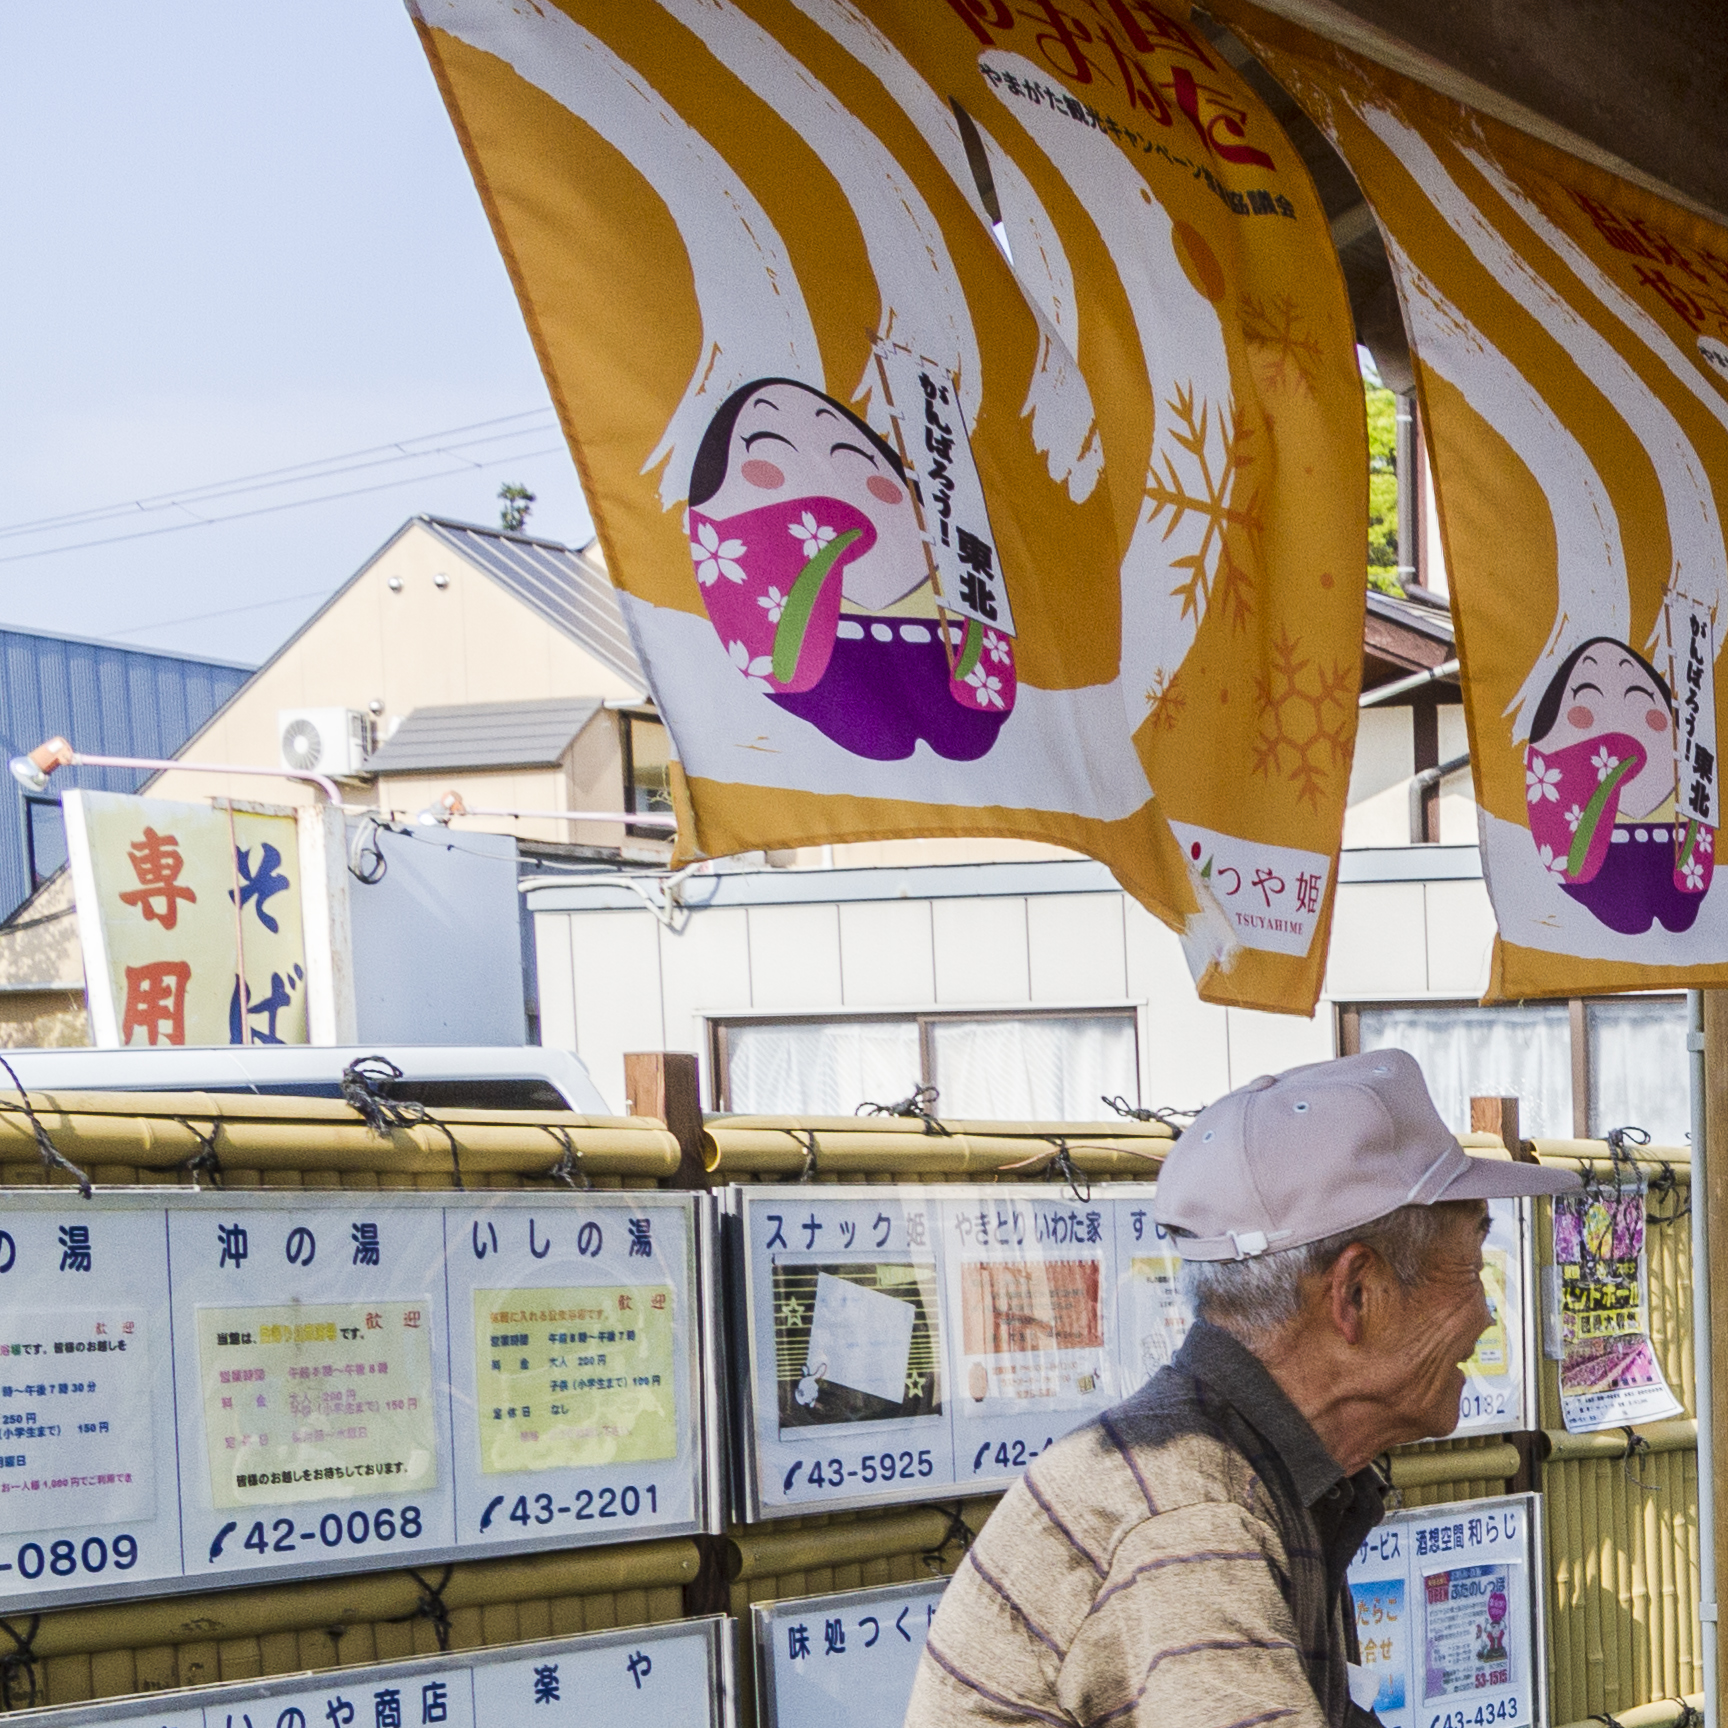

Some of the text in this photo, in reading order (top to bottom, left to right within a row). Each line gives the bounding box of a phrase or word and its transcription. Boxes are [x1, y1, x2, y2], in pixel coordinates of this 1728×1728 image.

[955, 525, 998, 622] 東北
[1688, 742, 1715, 819] 東北
[1217, 867, 1323, 914] つや姫
[118, 826, 197, 1045] 専用
[229, 841, 303, 1045] そば
[1235, 911, 1304, 936] TSUYAHIME
[216, 1221, 381, 1270] 沖の湯
[471, 1216, 653, 1260] いしの湯
[765, 1211, 927, 1251] スナック姫
[954, 1208, 1103, 1248] やきとり いわた家
[365, 1310, 421, 1330] 歓迎
[807, 1448, 934, 1490] 43-5925
[508, 1483, 660, 1526] 43-2201
[243, 1505, 424, 1557] 42-0068
[1468, 1512, 1517, 1547] 和らじ
[533, 1650, 653, 1706] 楽や
